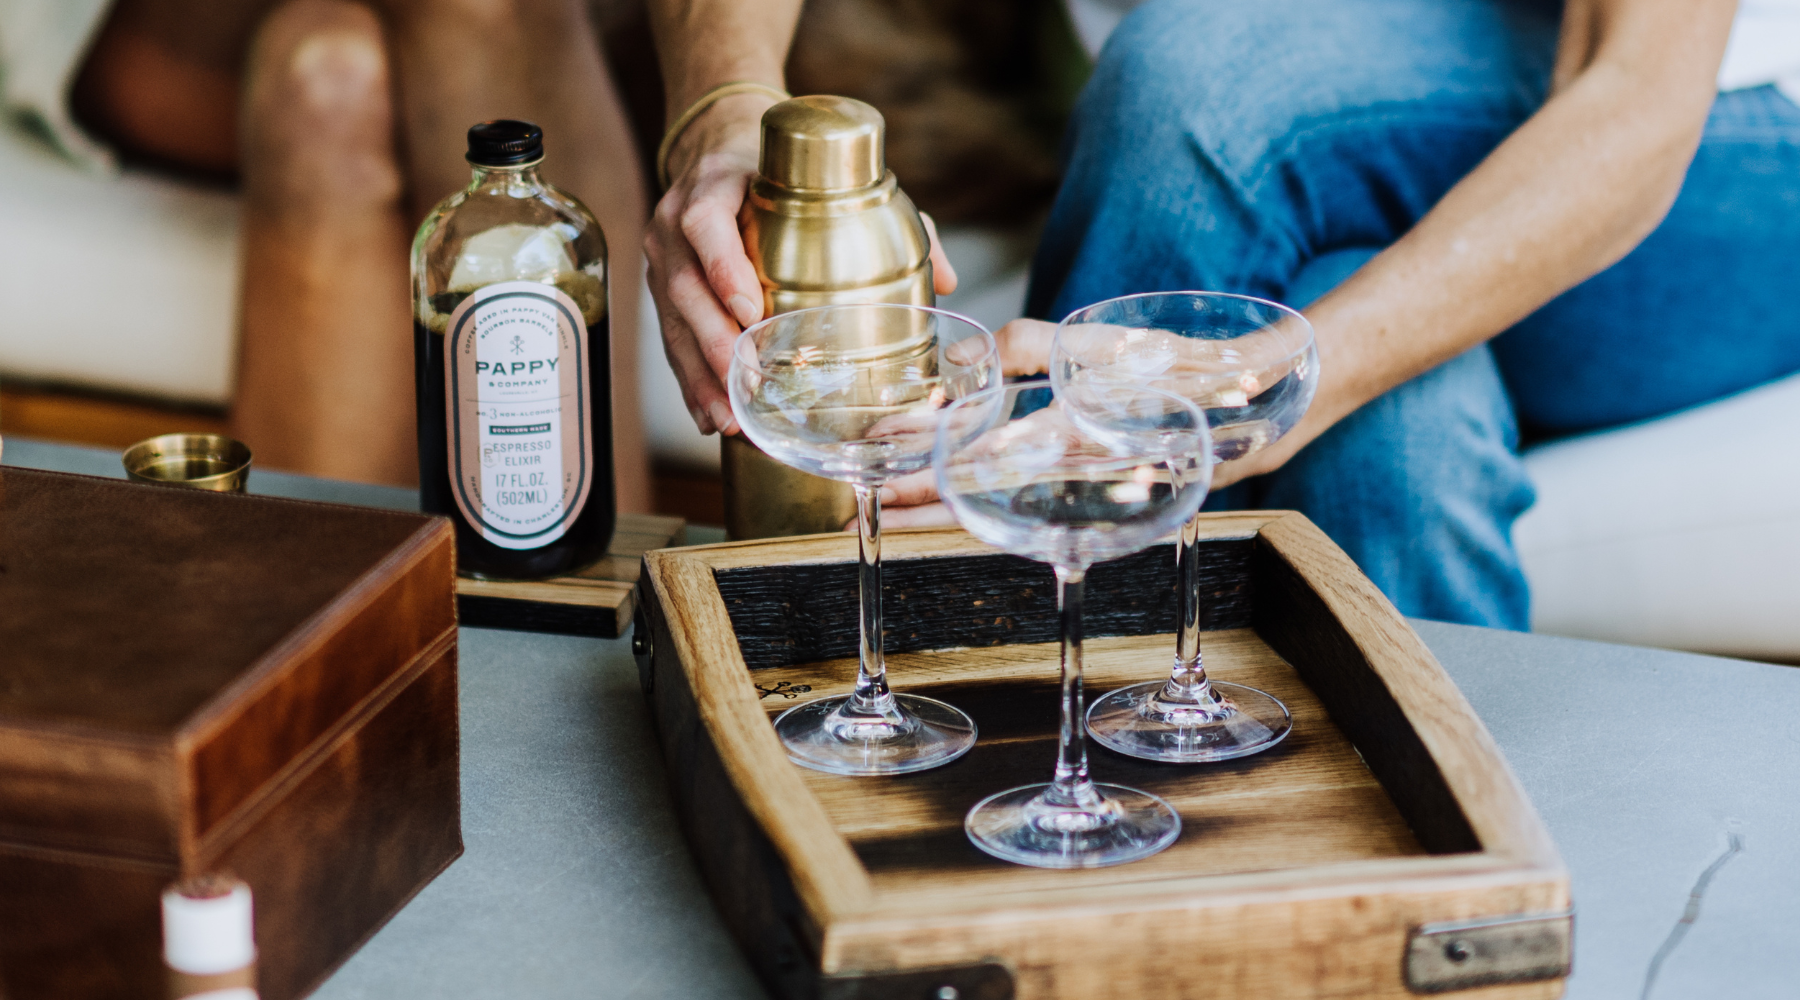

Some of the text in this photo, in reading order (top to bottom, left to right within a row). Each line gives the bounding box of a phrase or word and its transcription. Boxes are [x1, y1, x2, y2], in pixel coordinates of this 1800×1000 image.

[465, 325, 478, 354] COFFEE
[479, 312, 497, 325] AGED
[542, 312, 555, 322] VAN
[481, 319, 553, 339] BOURBON BARRELS
[476, 357, 559, 375] PAPPY
[497, 379, 548, 388] COMPANY
[490, 408, 498, 420] 3
[499, 407, 562, 418] NON-ALCOHOLIC
[493, 441, 551, 453] ESPRESSO
[505, 456, 541, 467] ELIXIR
[496, 472, 548, 488] 17 FL.OZ.
[471, 476, 510, 523] HANDCRAFTED
[496, 489, 548, 508] (502ML)
